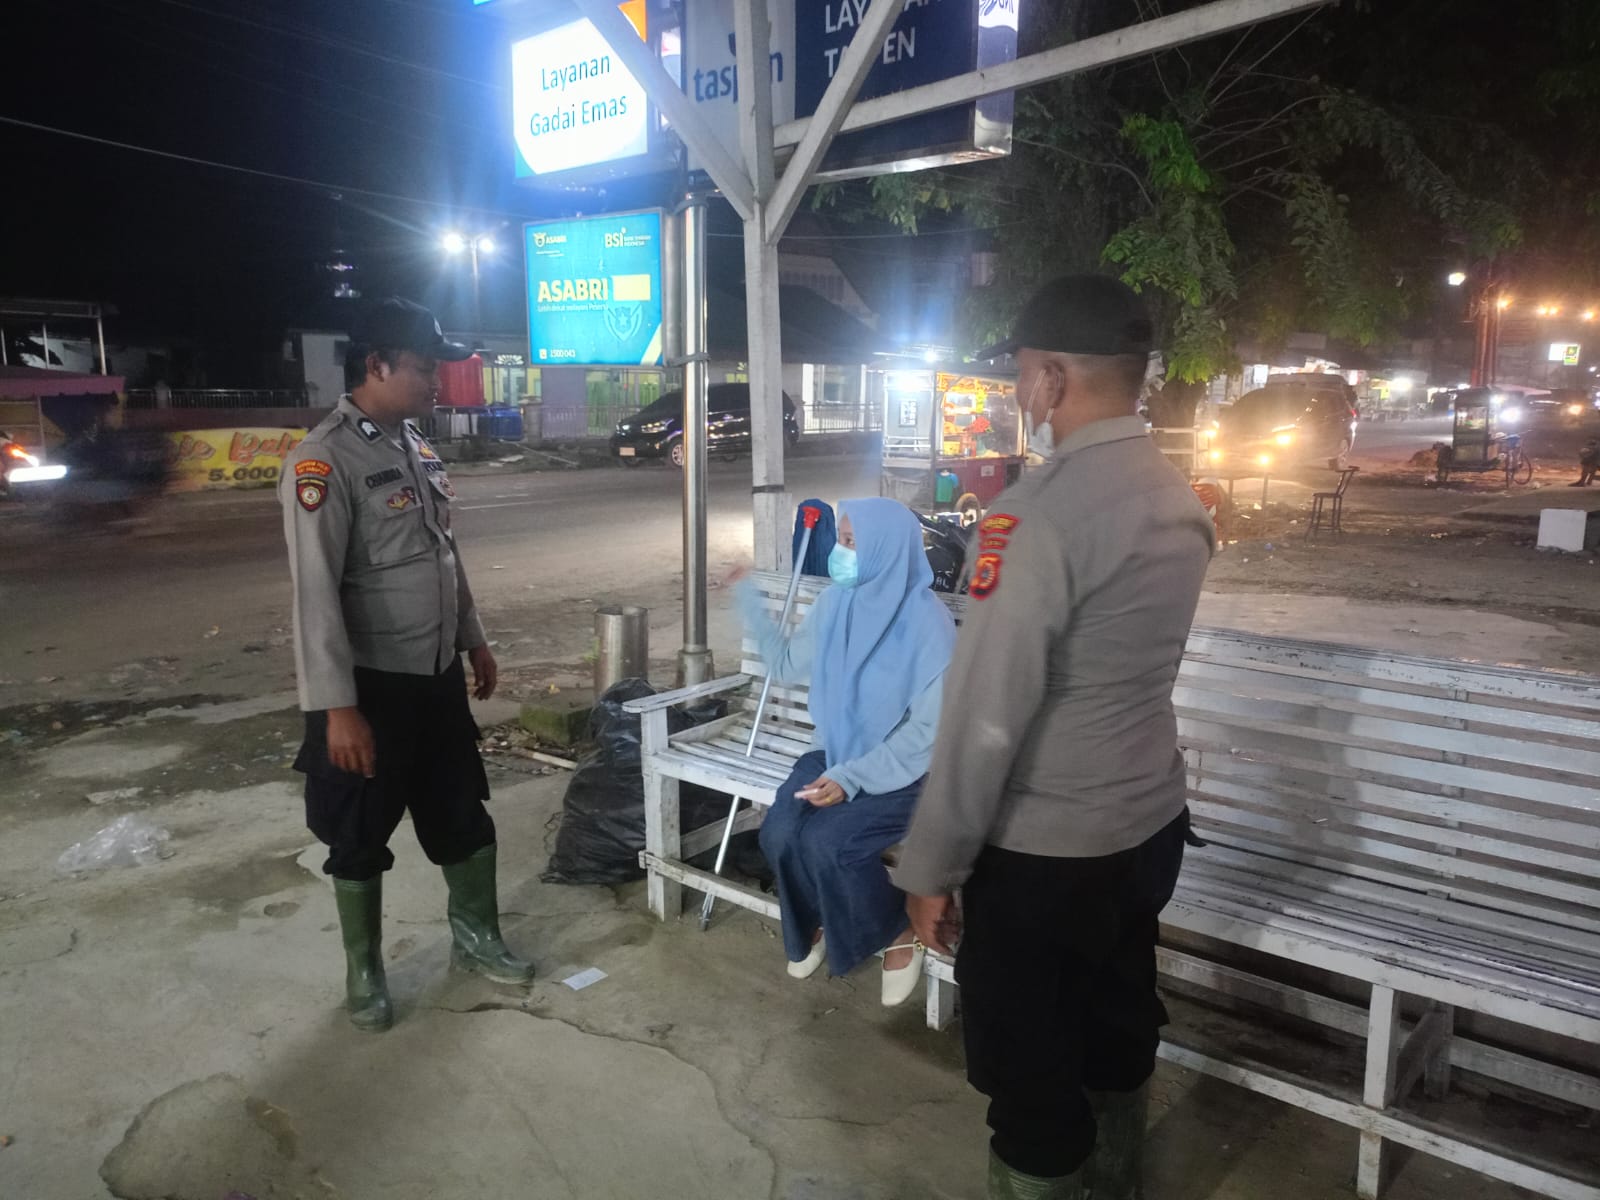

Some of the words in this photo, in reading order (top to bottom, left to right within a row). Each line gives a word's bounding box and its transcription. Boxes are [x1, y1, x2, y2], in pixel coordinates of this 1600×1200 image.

[542, 55, 610, 91] Layanan
[530, 104, 575, 136] Gadai
[582, 95, 627, 125] Emas
[604, 229, 625, 248] BSI
[538, 278, 608, 302] ASABRI
[209, 466, 278, 481] 5.000
